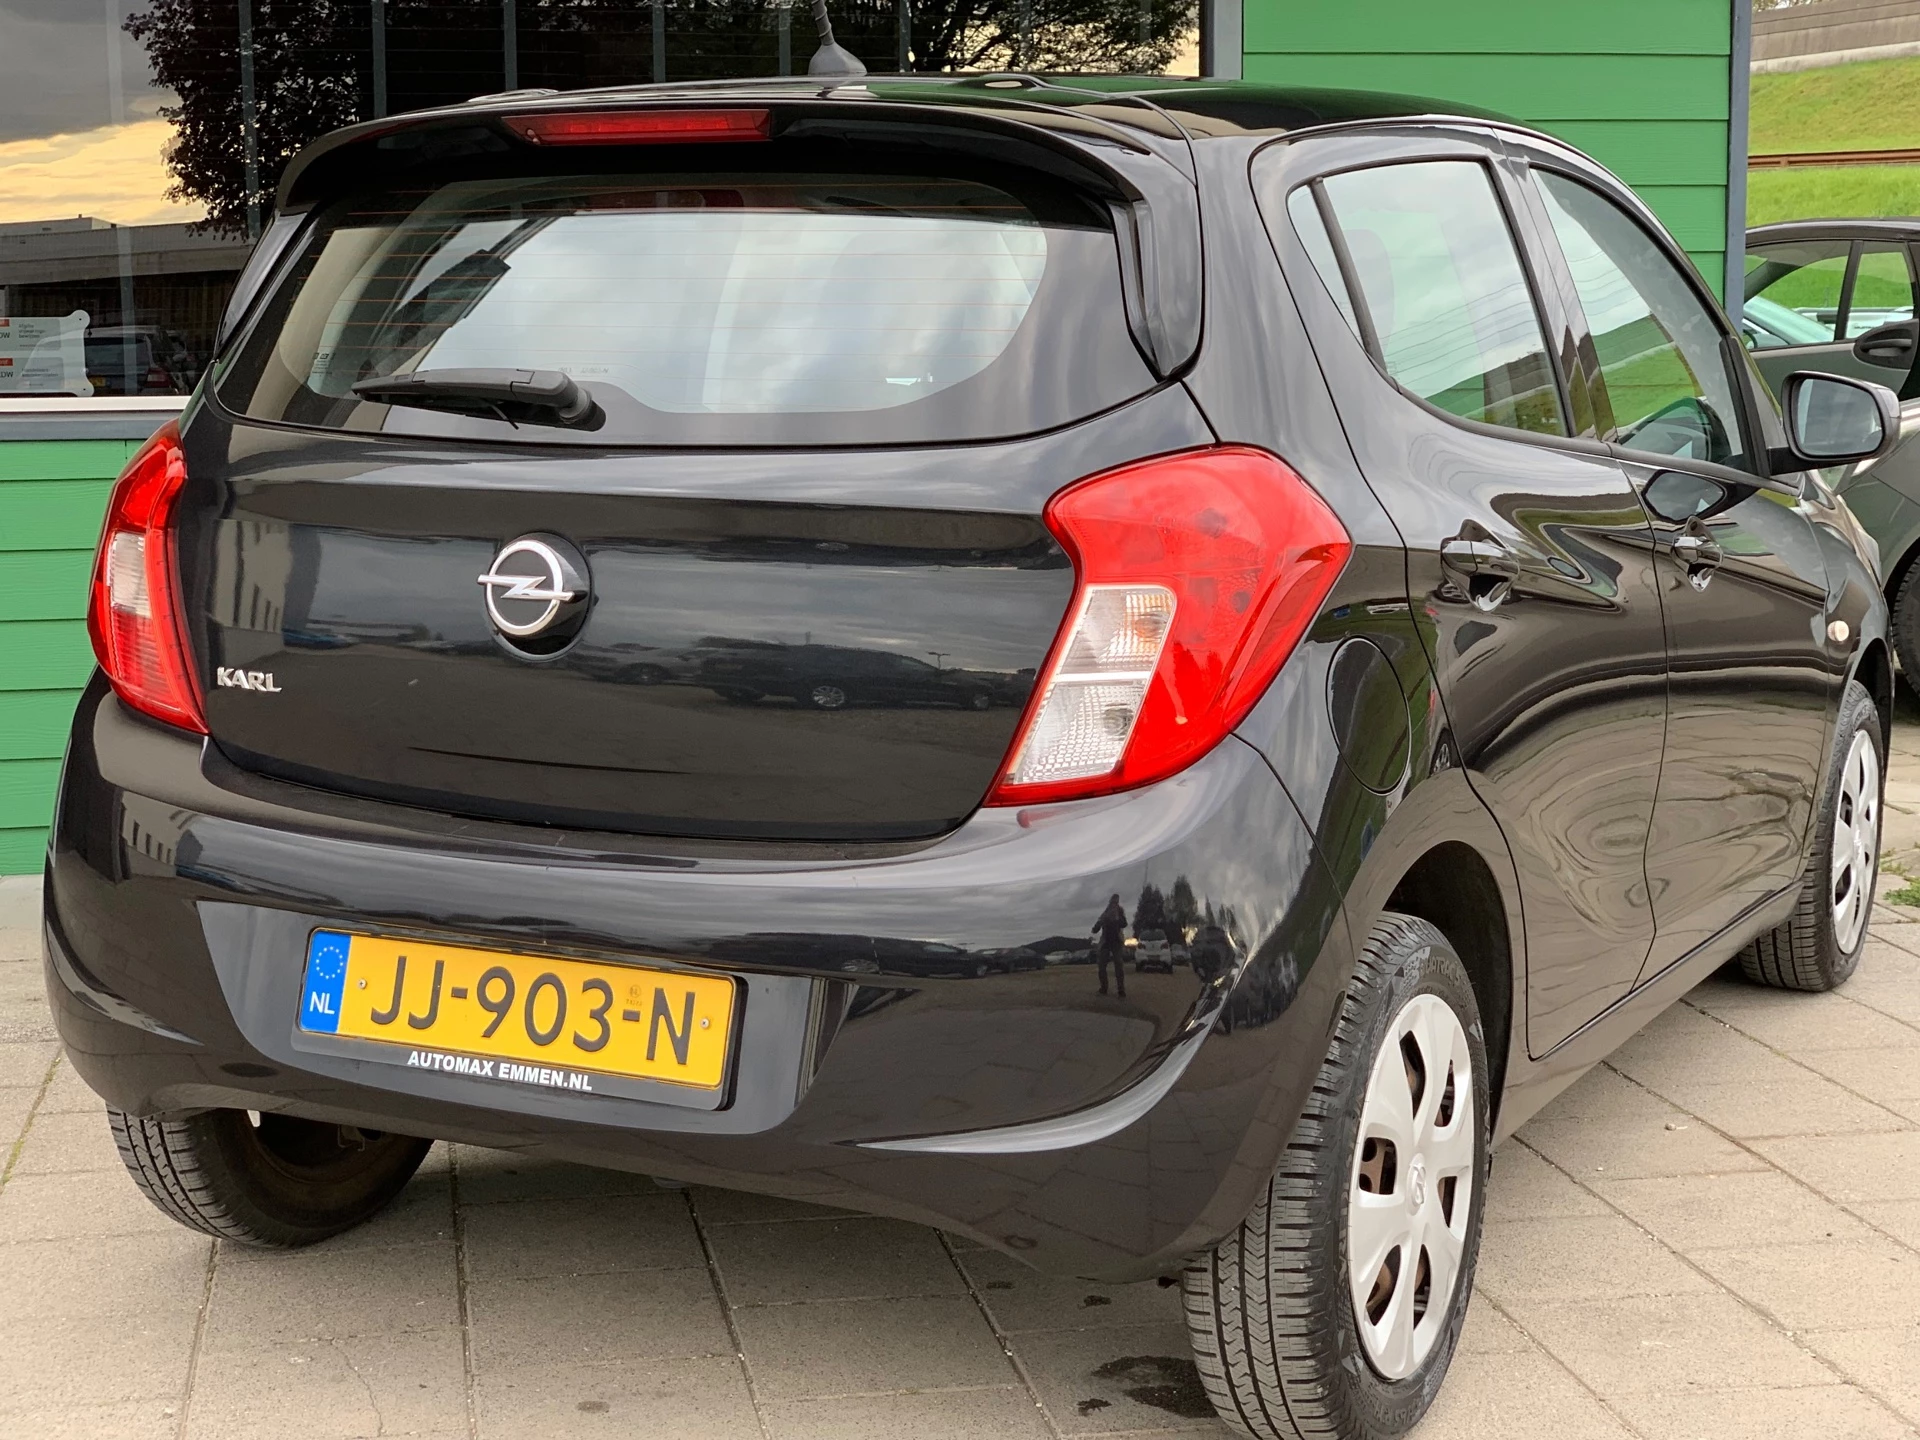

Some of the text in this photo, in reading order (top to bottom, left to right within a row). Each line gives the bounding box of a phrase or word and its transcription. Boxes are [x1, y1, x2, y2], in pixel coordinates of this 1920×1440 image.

[217, 666, 282, 692] KARL
[309, 991, 335, 1015] NL
[370, 955, 696, 1066] JJ-903-N
[407, 1050, 593, 1091] AUTOMAX EMMEN.NL
